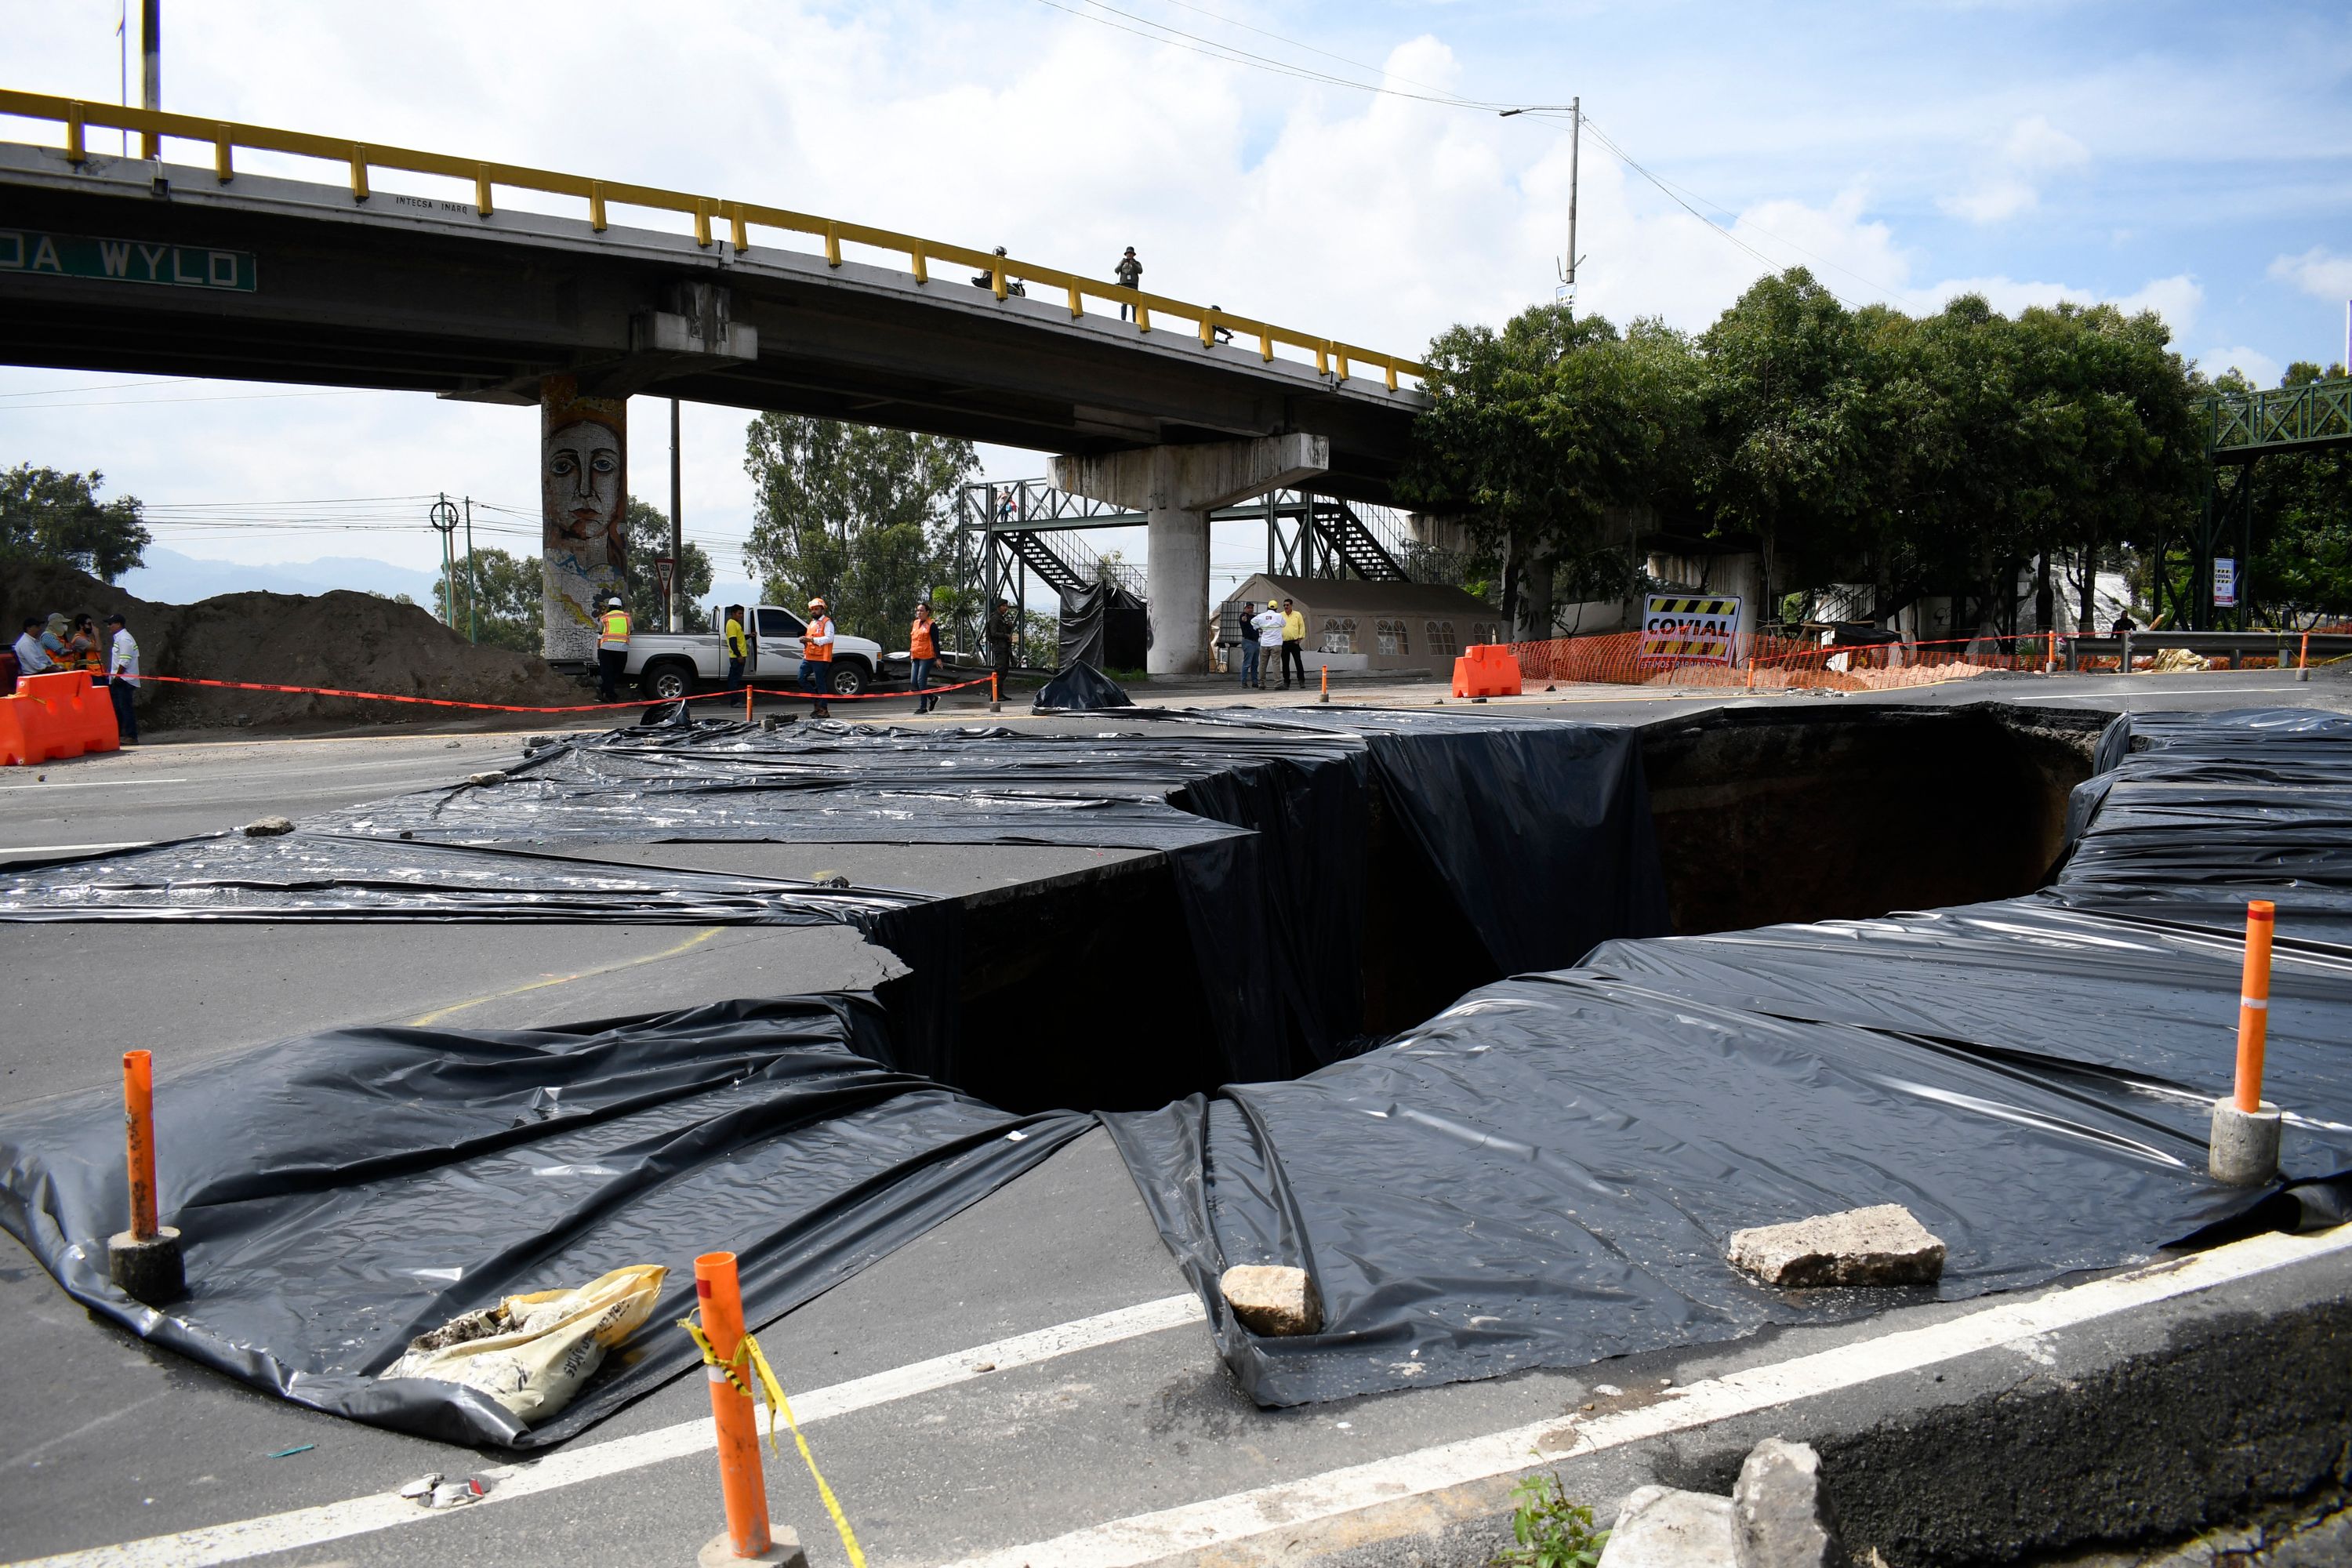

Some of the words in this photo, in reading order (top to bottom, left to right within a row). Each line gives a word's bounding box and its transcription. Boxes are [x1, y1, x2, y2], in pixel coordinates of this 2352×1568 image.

[396, 197, 433, 208] INTECSA
[441, 203, 468, 215] INARQ
[0, 230, 63, 272] DA
[100, 240, 238, 287] WYLD
[1647, 618, 1730, 637] COVIAL
[1640, 660, 1669, 669] ESTAMOS
